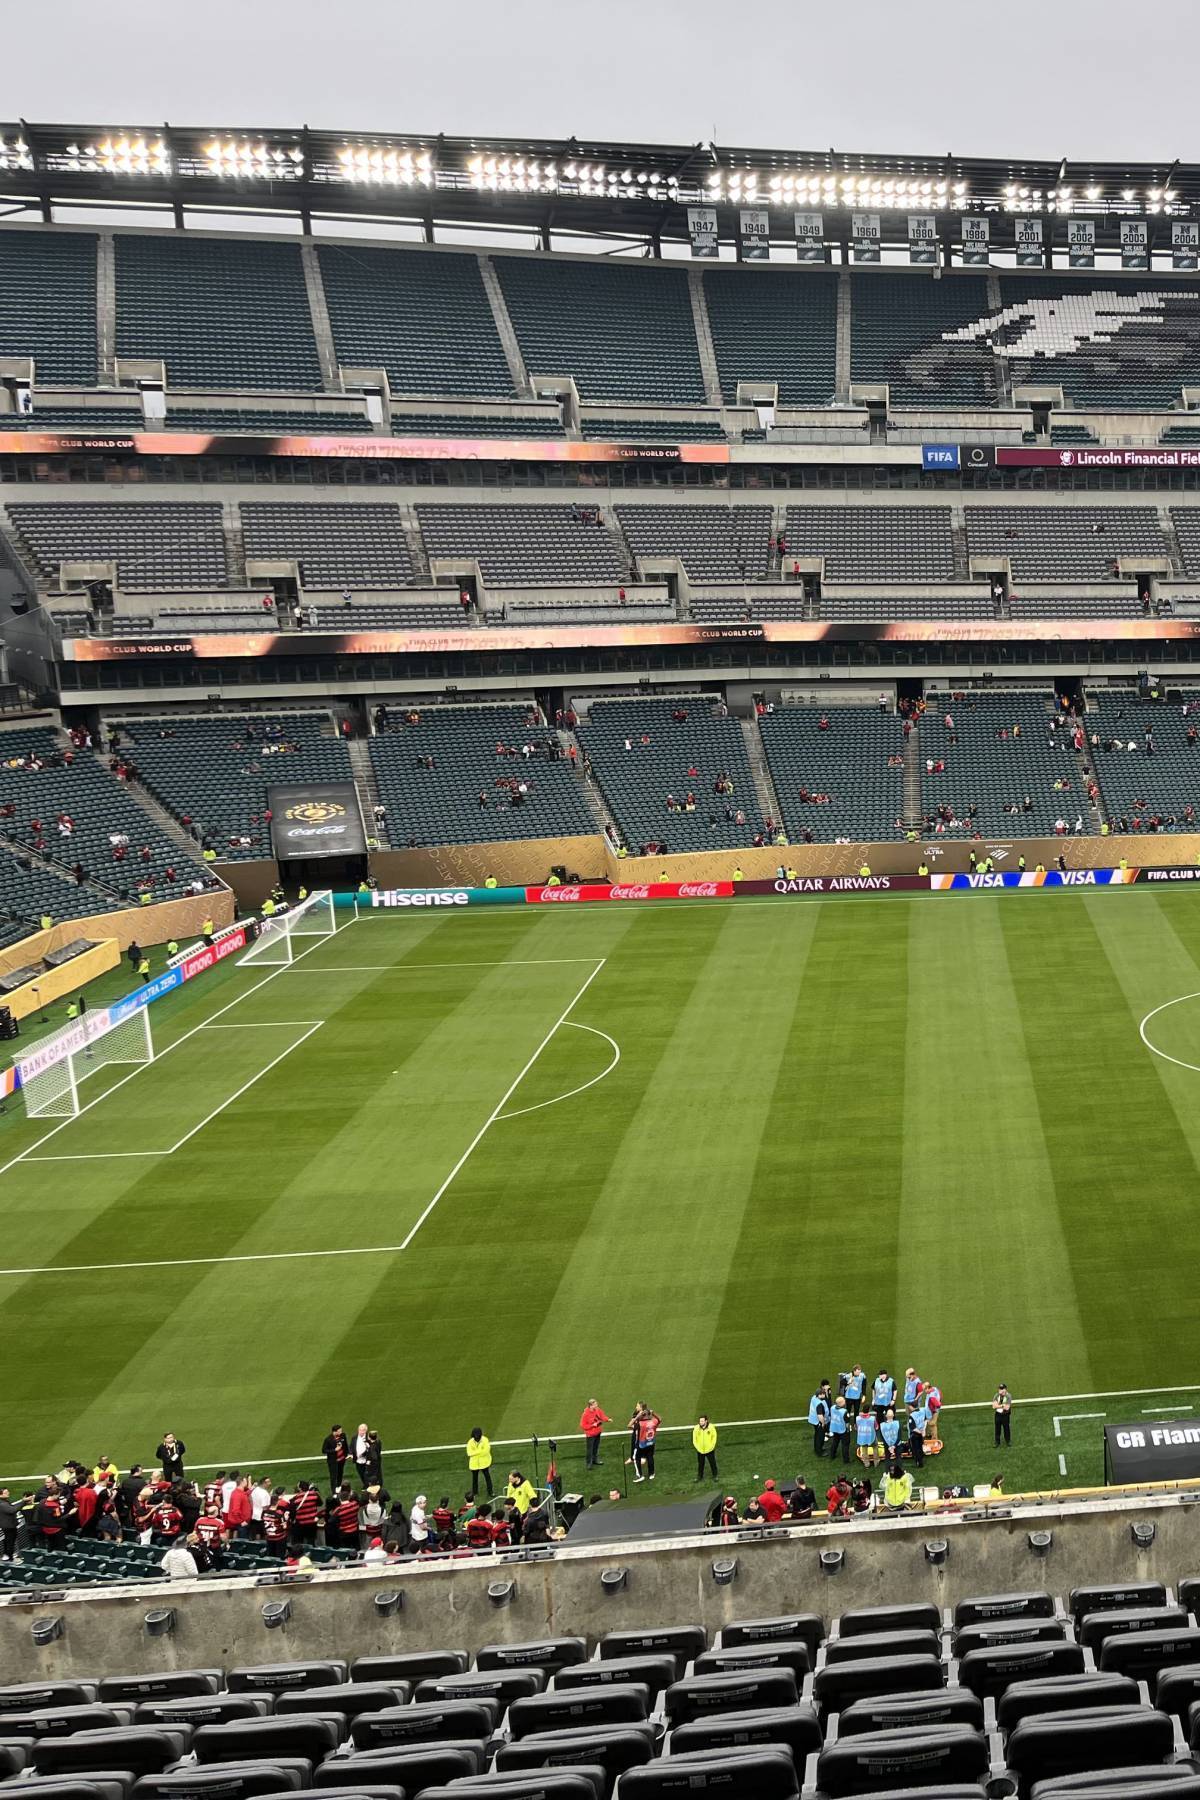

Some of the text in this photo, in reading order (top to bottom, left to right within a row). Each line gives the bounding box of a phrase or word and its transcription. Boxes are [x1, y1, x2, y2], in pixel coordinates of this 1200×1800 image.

[692, 222, 714, 231] 1947
[799, 225, 820, 235] 1949
[856, 227, 877, 237] 1960
[912, 229, 933, 238] 1980
[1019, 232, 1039, 241] 2001
[1070, 233, 1093, 242] 2002
[1123, 234, 1145, 242] 2003
[1174, 235, 1196, 244] 2004
[928, 452, 952, 462] FIFA
[1078, 452, 1122, 464] Lincoln
[1124, 452, 1178, 464] Financial
[1057, 871, 1096, 885] VISA
[1148, 872, 1168, 880] FIFA
[1170, 871, 1194, 879] CLUB
[774, 876, 890, 894] QATAR AIRWAYS
[964, 874, 1004, 888] VISA
[372, 890, 468, 907] Hisense
[216, 934, 244, 958] Lenovo
[184, 952, 213, 979] Lenovo
[1116, 1431, 1146, 1448] CR
